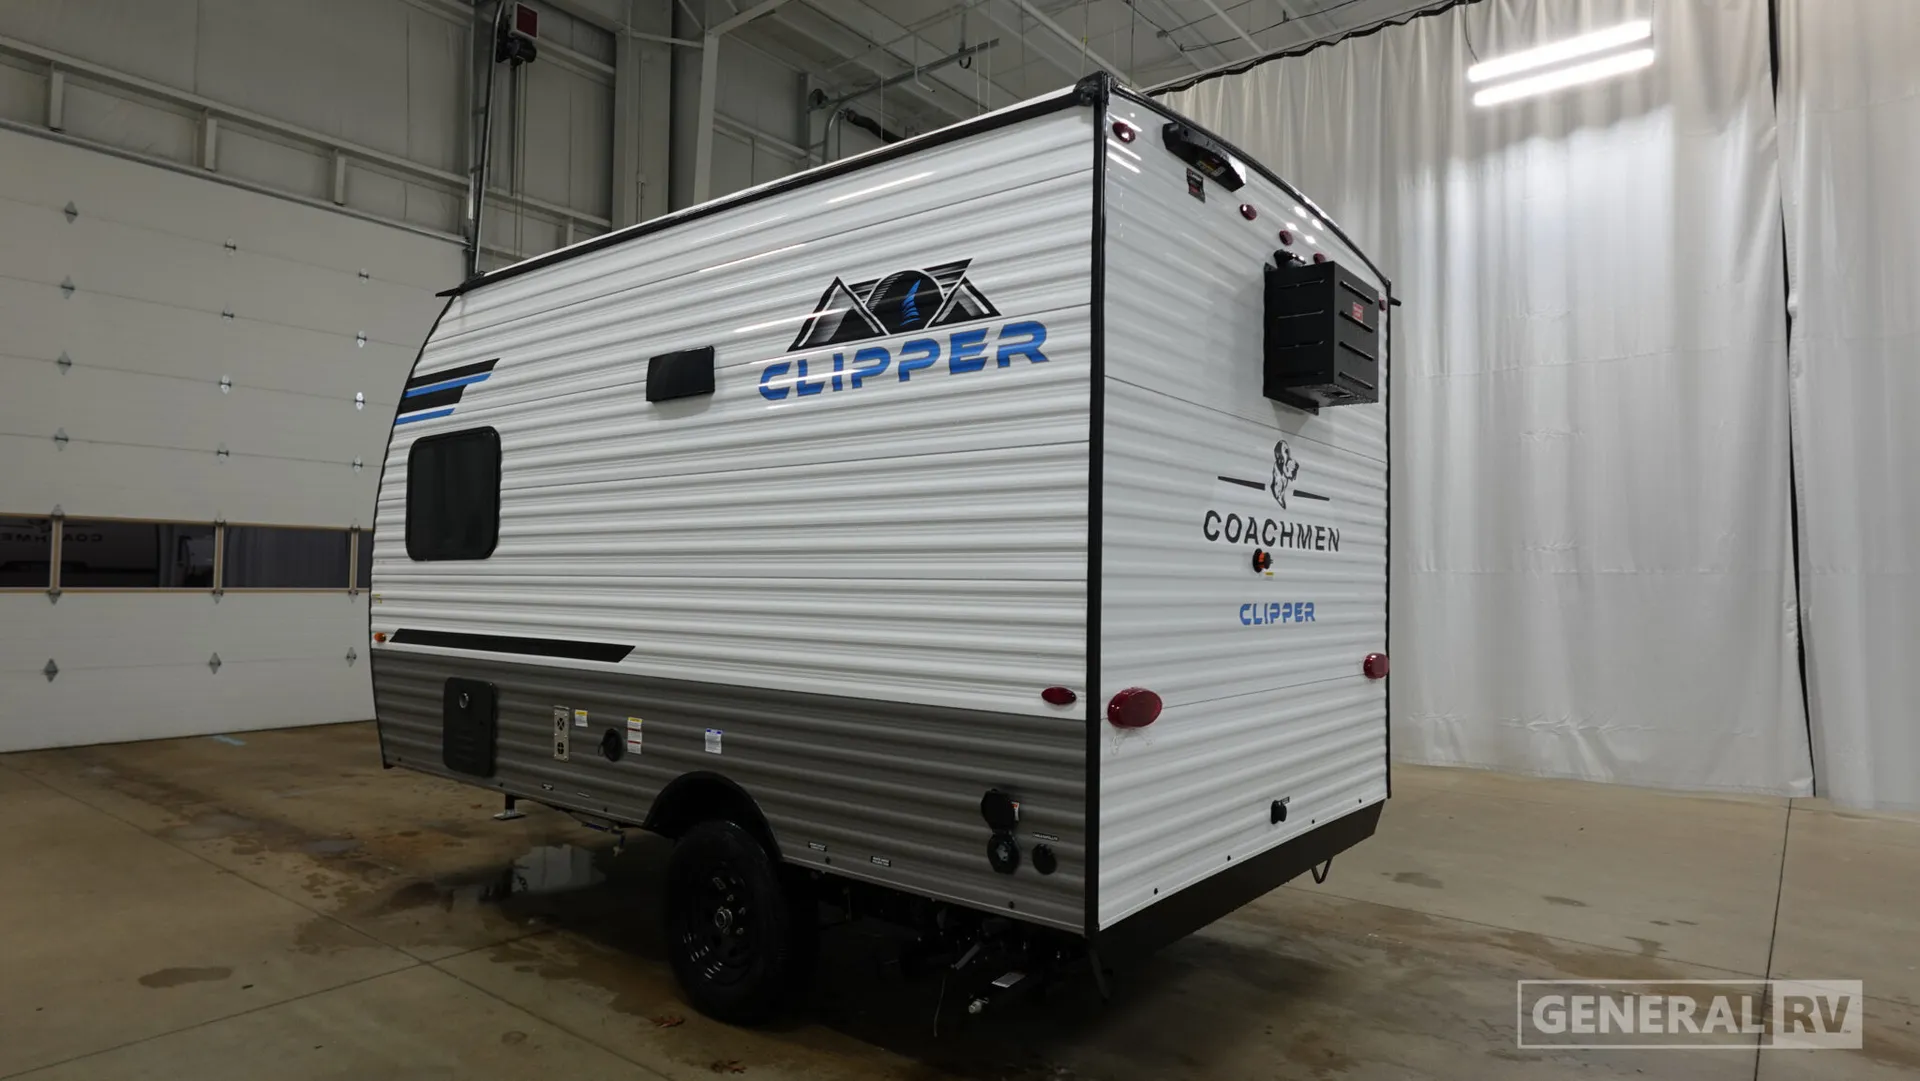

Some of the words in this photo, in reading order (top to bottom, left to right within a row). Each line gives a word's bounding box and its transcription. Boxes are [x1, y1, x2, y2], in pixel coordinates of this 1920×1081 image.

[758, 320, 1050, 401] CLIPPER
[1203, 510, 1341, 552] COACHMEN
[1239, 602, 1316, 626] CLIPPER
